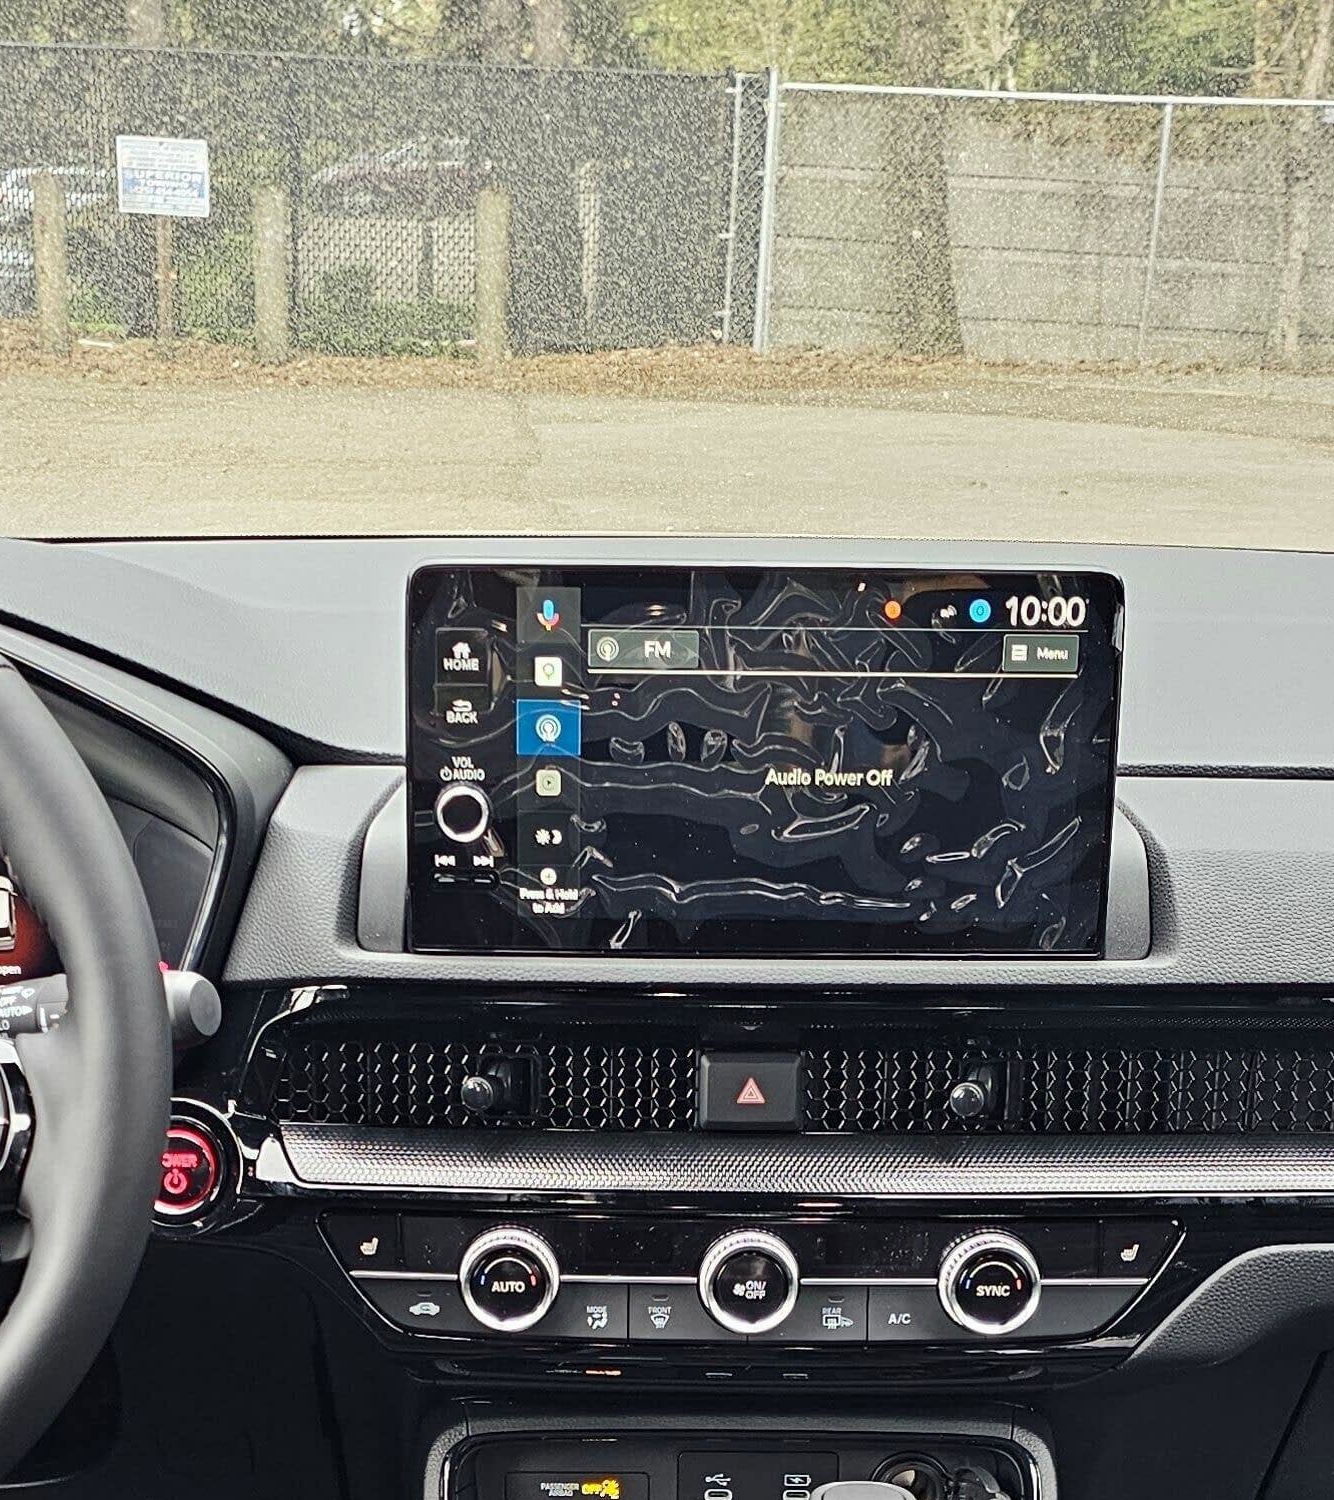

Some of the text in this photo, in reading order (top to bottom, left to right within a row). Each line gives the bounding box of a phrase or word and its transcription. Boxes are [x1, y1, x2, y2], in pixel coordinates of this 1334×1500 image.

[1005, 595, 1086, 627] 10:00
[644, 640, 671, 659] FM
[1036, 646, 1069, 660] Menu
[443, 658, 480, 671] HOME
[446, 711, 478, 724] BACK
[451, 756, 474, 769] VOL
[453, 769, 486, 781] AUDIO
[765, 769, 893, 787] Audio Power Off
[162, 1153, 197, 1167] OWER
[491, 1281, 526, 1293] AUTO
[976, 1286, 1010, 1298] SYNC
[745, 1290, 765, 1299] OFF
[587, 1306, 607, 1314] MODE
[648, 1306, 672, 1315] FRONT
[822, 1307, 842, 1315] REAR
[888, 1314, 911, 1325] A/C
